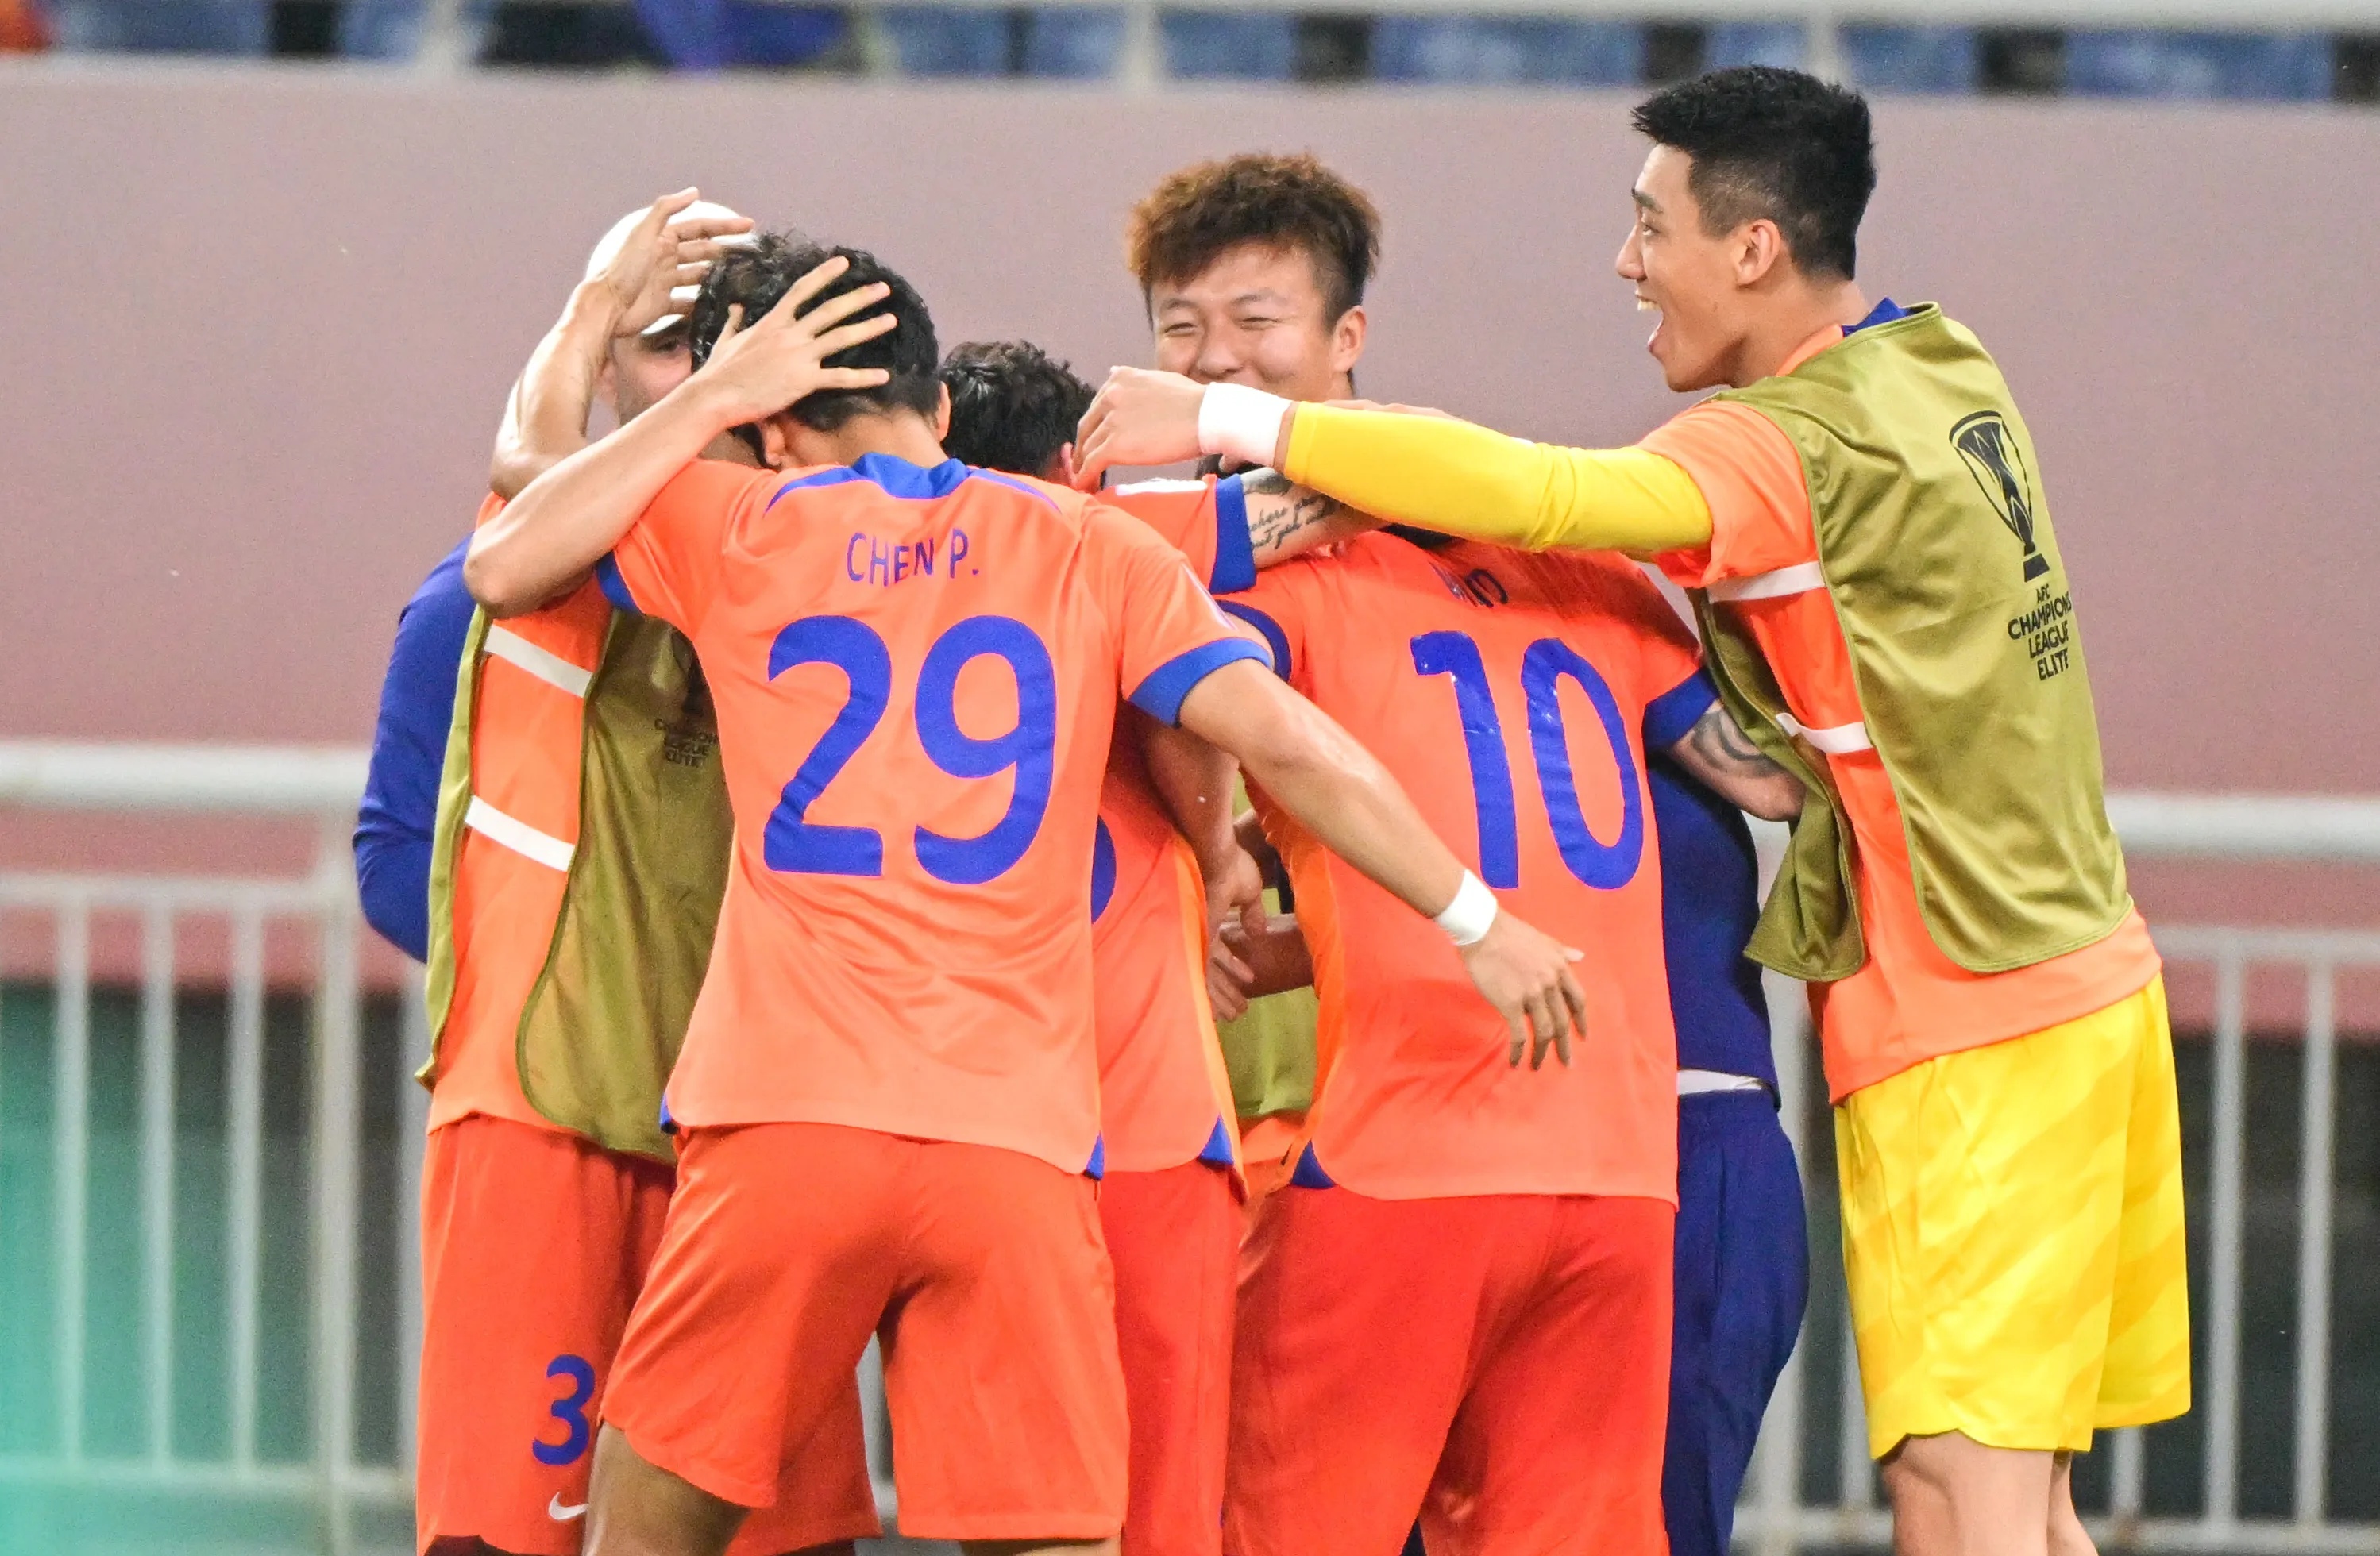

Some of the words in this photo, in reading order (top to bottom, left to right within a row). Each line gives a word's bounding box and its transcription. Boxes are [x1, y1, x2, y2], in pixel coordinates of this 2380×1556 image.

[847, 532, 935, 587] CHEN
[950, 527, 980, 580] P.
[2035, 584, 2050, 604] AFC
[763, 614, 1057, 885] 29
[1410, 630, 1645, 891] 10
[532, 1354, 596, 1466] 3
